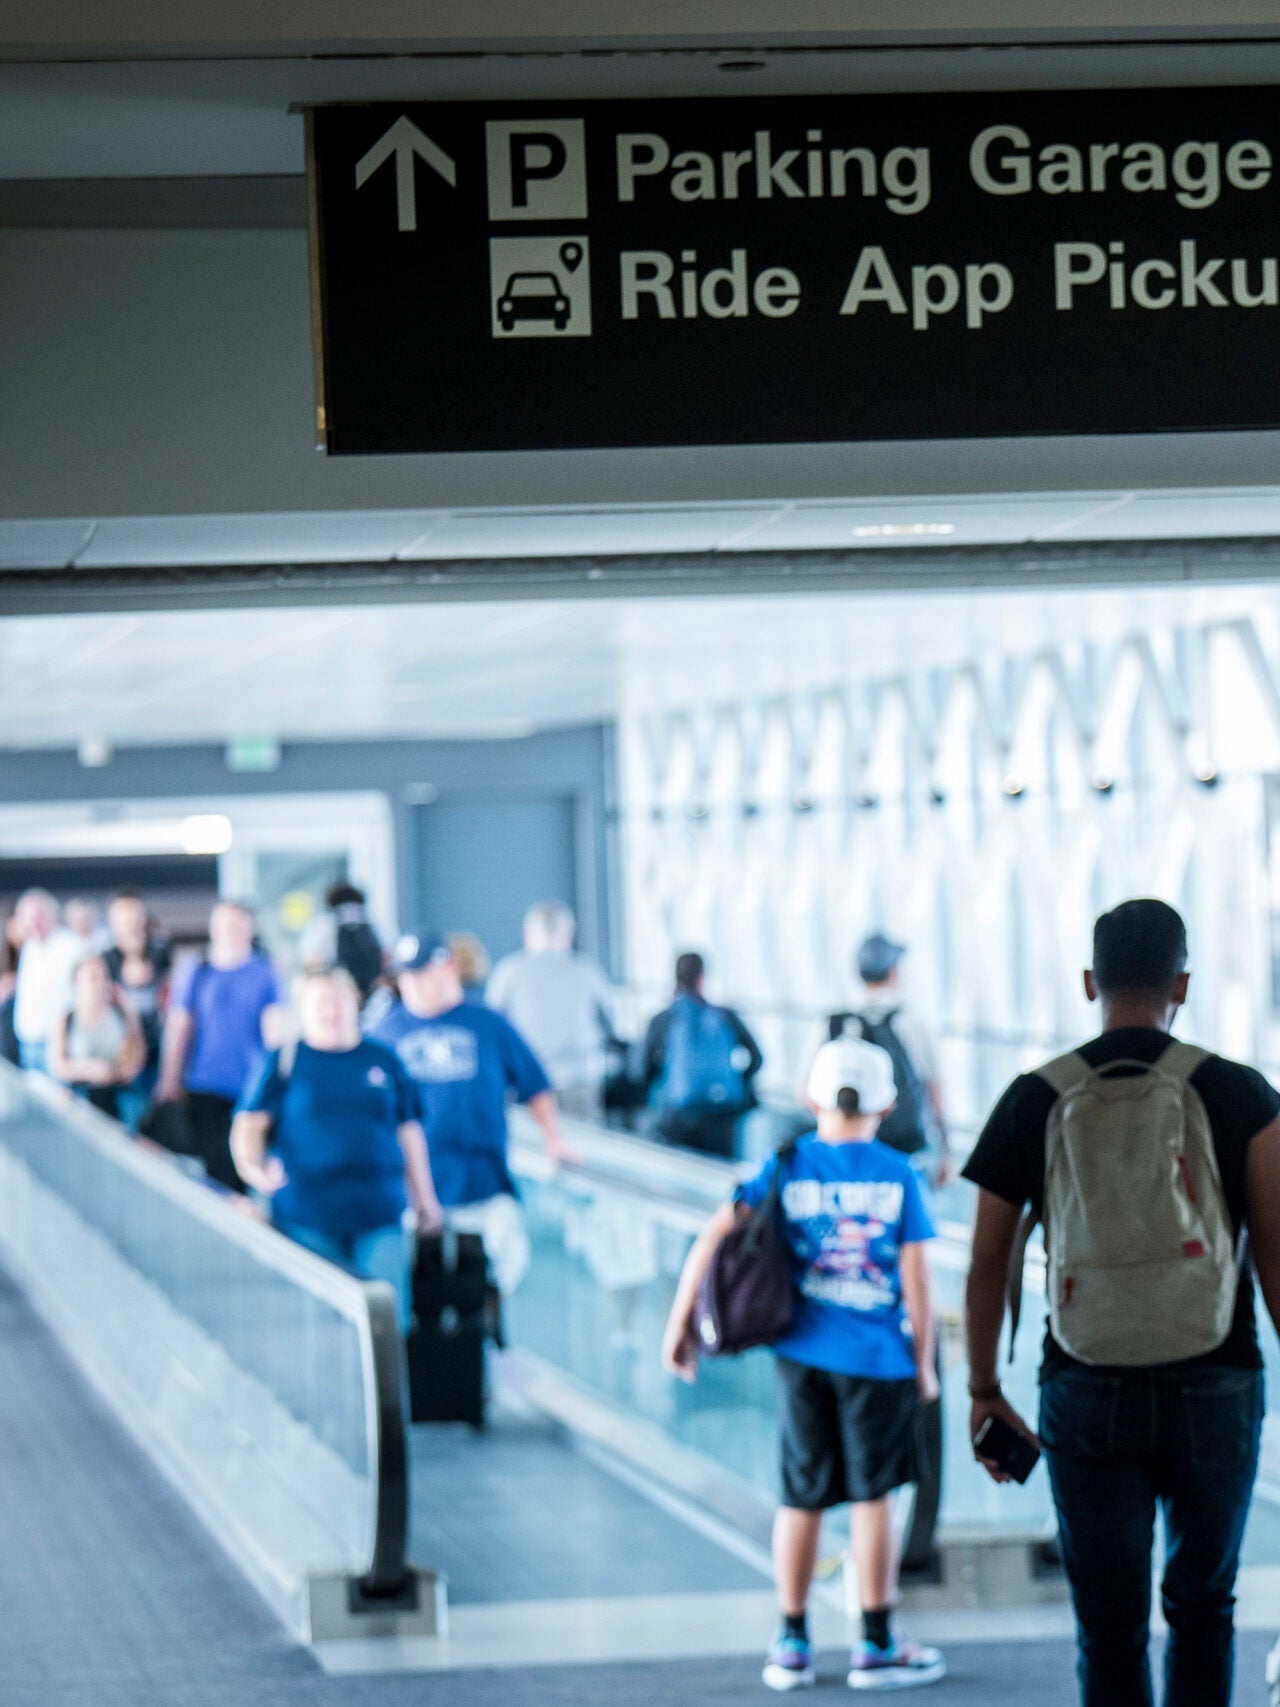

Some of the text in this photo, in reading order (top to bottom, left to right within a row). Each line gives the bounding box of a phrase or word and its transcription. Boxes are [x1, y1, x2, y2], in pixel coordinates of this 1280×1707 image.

[509, 132, 568, 208] P
[617, 125, 1272, 215] Parking Garage
[620, 249, 801, 319] Ride
[839, 246, 1014, 330] App
